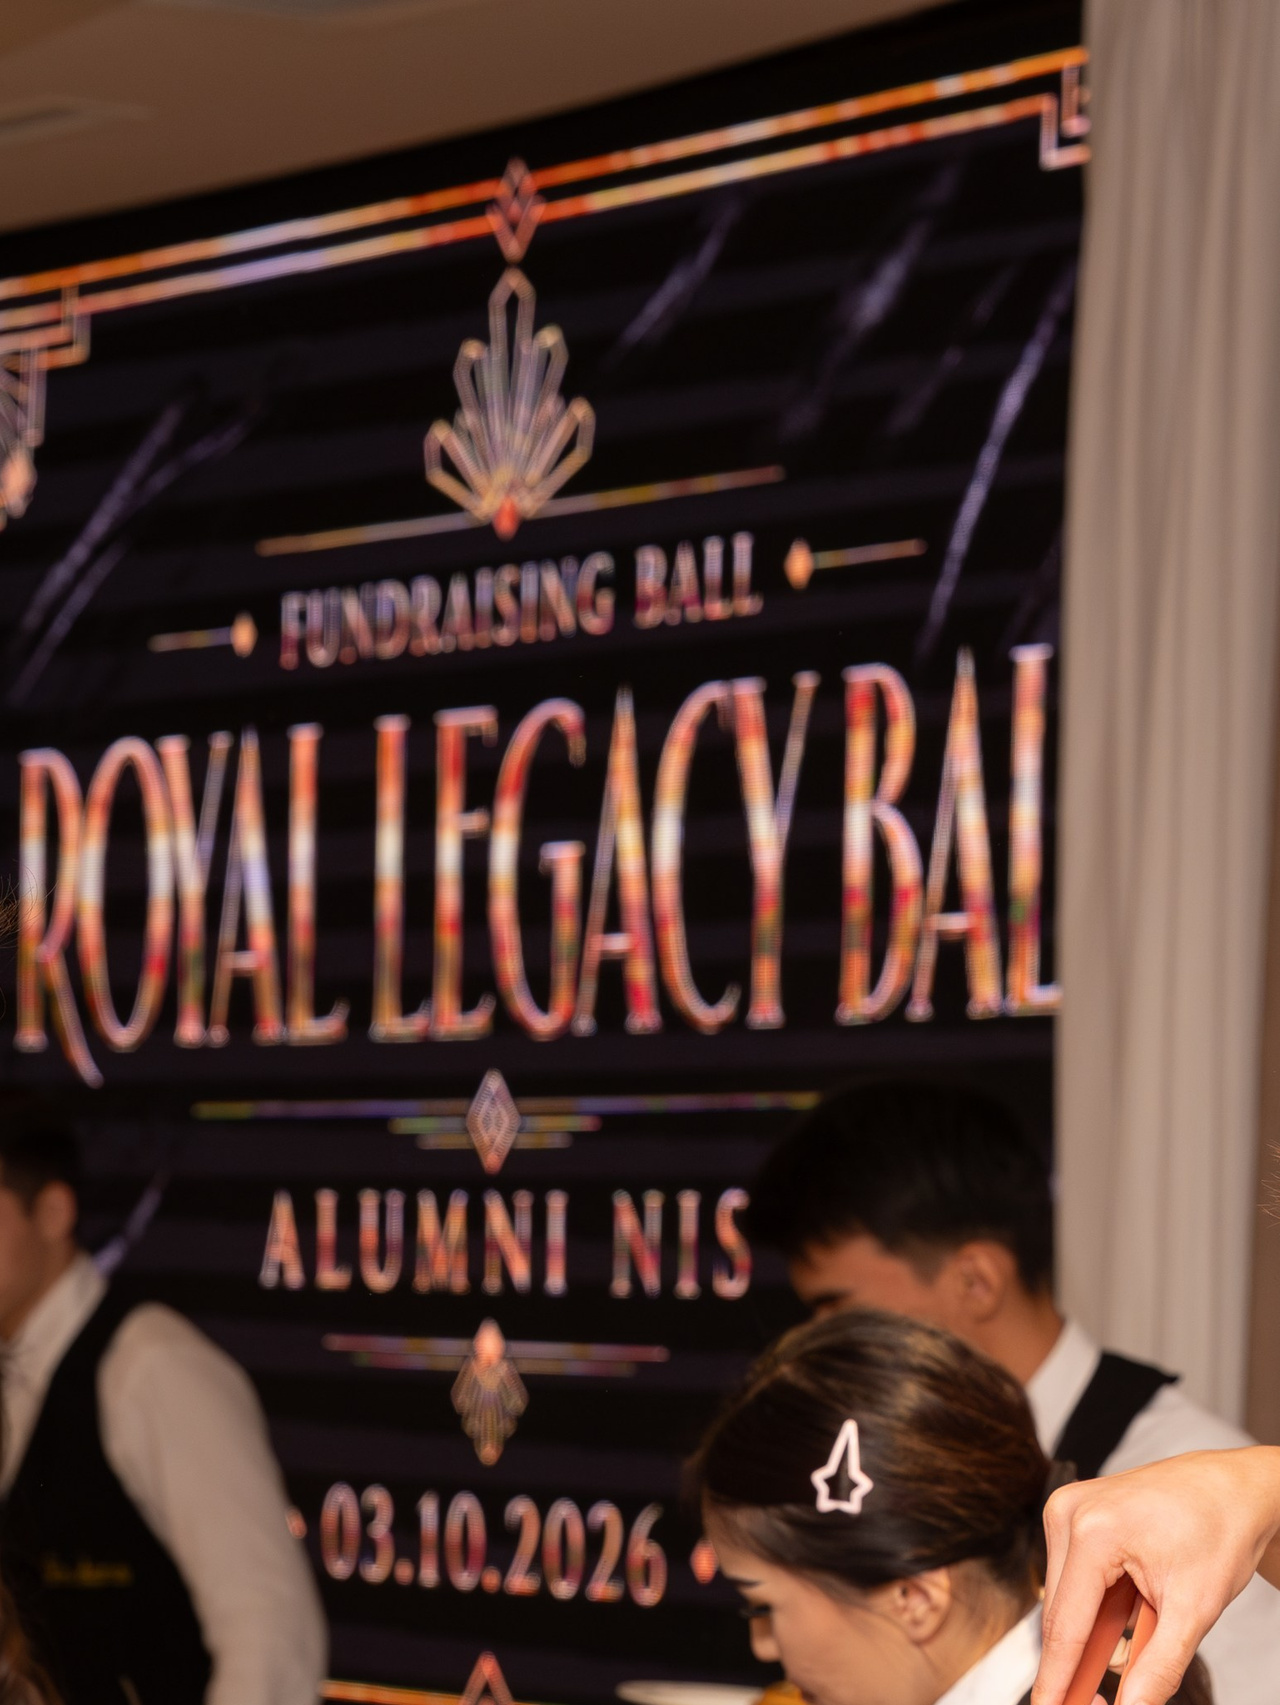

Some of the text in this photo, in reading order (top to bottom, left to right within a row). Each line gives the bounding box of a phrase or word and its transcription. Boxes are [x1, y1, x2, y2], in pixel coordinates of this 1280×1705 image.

[280, 533, 762, 668] FUNDRAISING BALL
[17, 725, 348, 1087] ROYAL
[369, 670, 821, 1040] LEGACY
[260, 1188, 752, 1298] ALUMNI NIS
[322, 1483, 667, 1606] 03.10.2026
